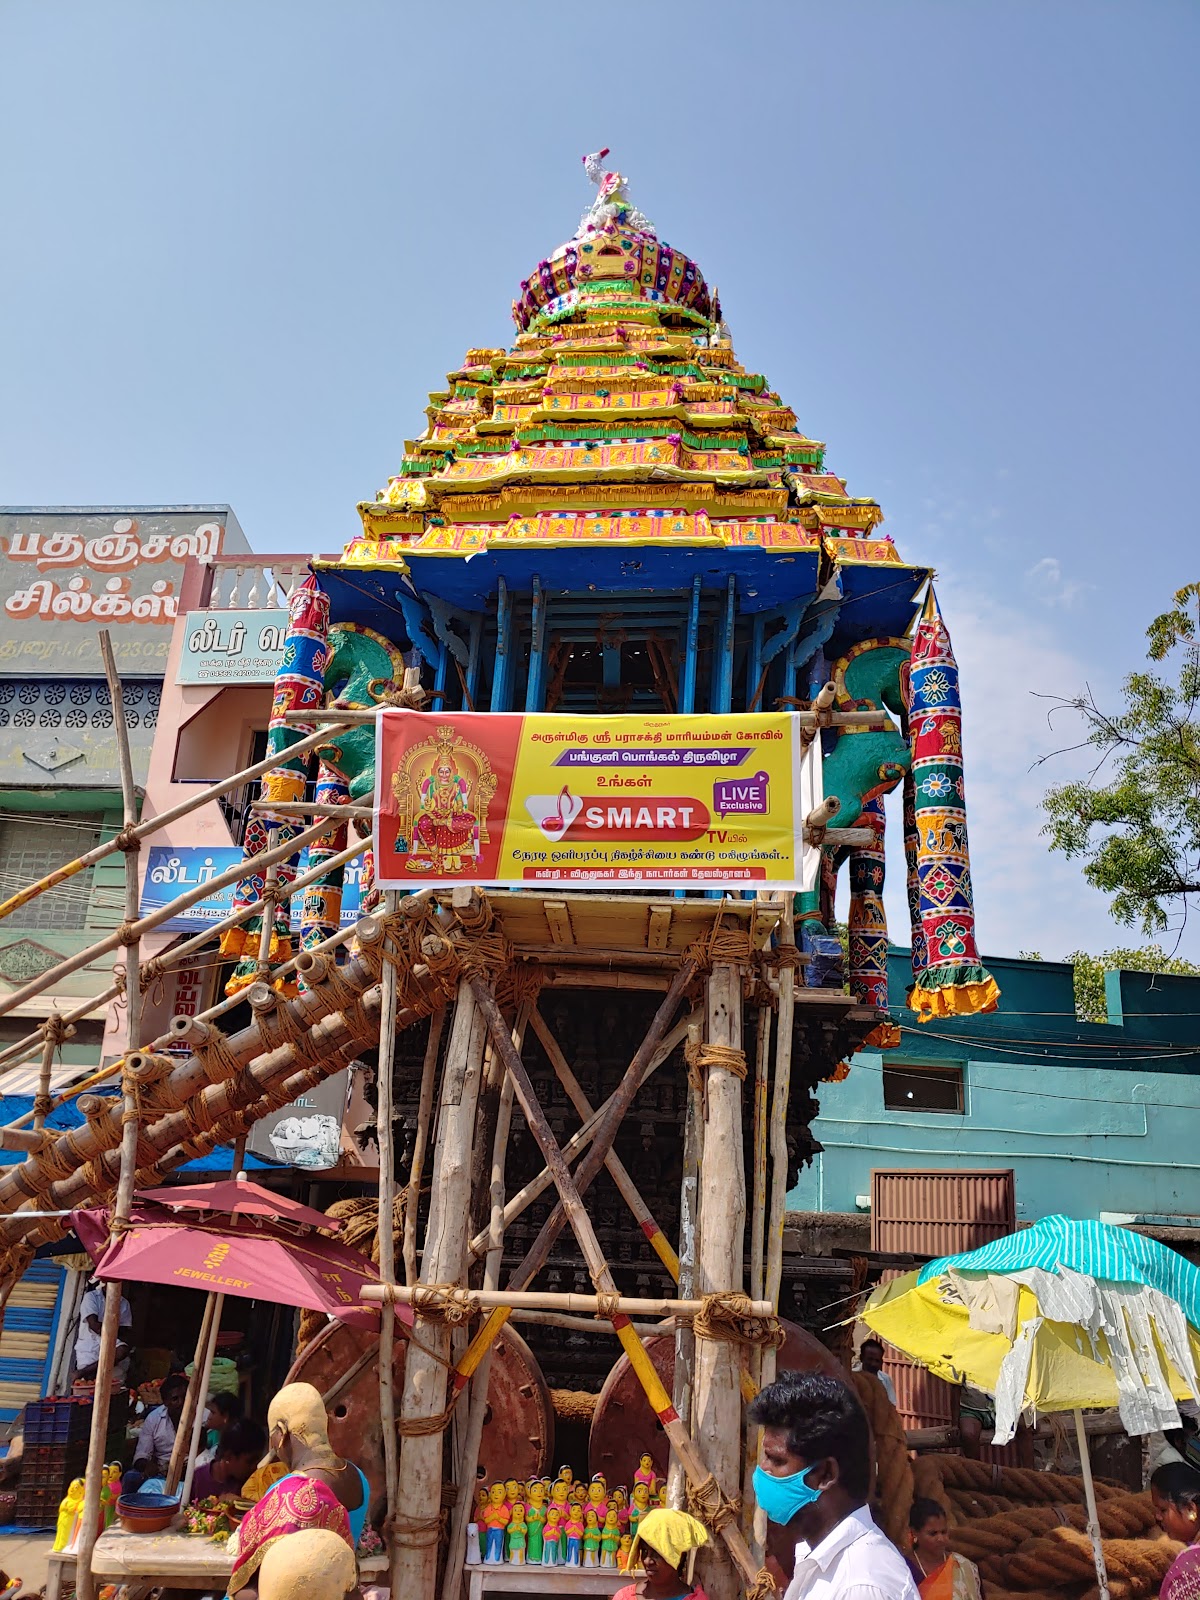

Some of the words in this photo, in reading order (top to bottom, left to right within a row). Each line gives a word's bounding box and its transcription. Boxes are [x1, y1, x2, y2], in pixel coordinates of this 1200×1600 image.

[8, 517, 221, 570] பதஞ்சலி
[5, 576, 180, 624] சில்க்ஸ்
[188, 618, 248, 657] லீடர்
[530, 731, 589, 744] அருள்மிகு
[615, 731, 662, 744] பராசக்தி
[666, 730, 732, 741] மாரியம்மன்
[736, 729, 783, 741] கோவில்
[569, 750, 619, 763] பங்குனி
[622, 750, 680, 762] பொங்கல்
[682, 750, 738, 764] திருவிழா
[596, 774, 653, 788] உங்கள்
[721, 785, 760, 801] LIVE
[719, 801, 763, 810] Exclusive
[585, 806, 694, 829] SMART
[512, 849, 548, 862] நேரடி
[551, 848, 608, 862] ஒளிபரப்பு
[611, 848, 677, 862] நிகழ்ச்சியை
[680, 848, 715, 861] கண்டு
[151, 857, 217, 885] லீடர்
[535, 868, 560, 879] நன்றி
[570, 868, 615, 880] விருதுநகர்
[618, 868, 642, 880] இந்து
[645, 868, 688, 879] நாடார்கள்
[691, 867, 751, 880] தேவஸ்தானம்
[173, 1267, 253, 1290] JEWELLERY
